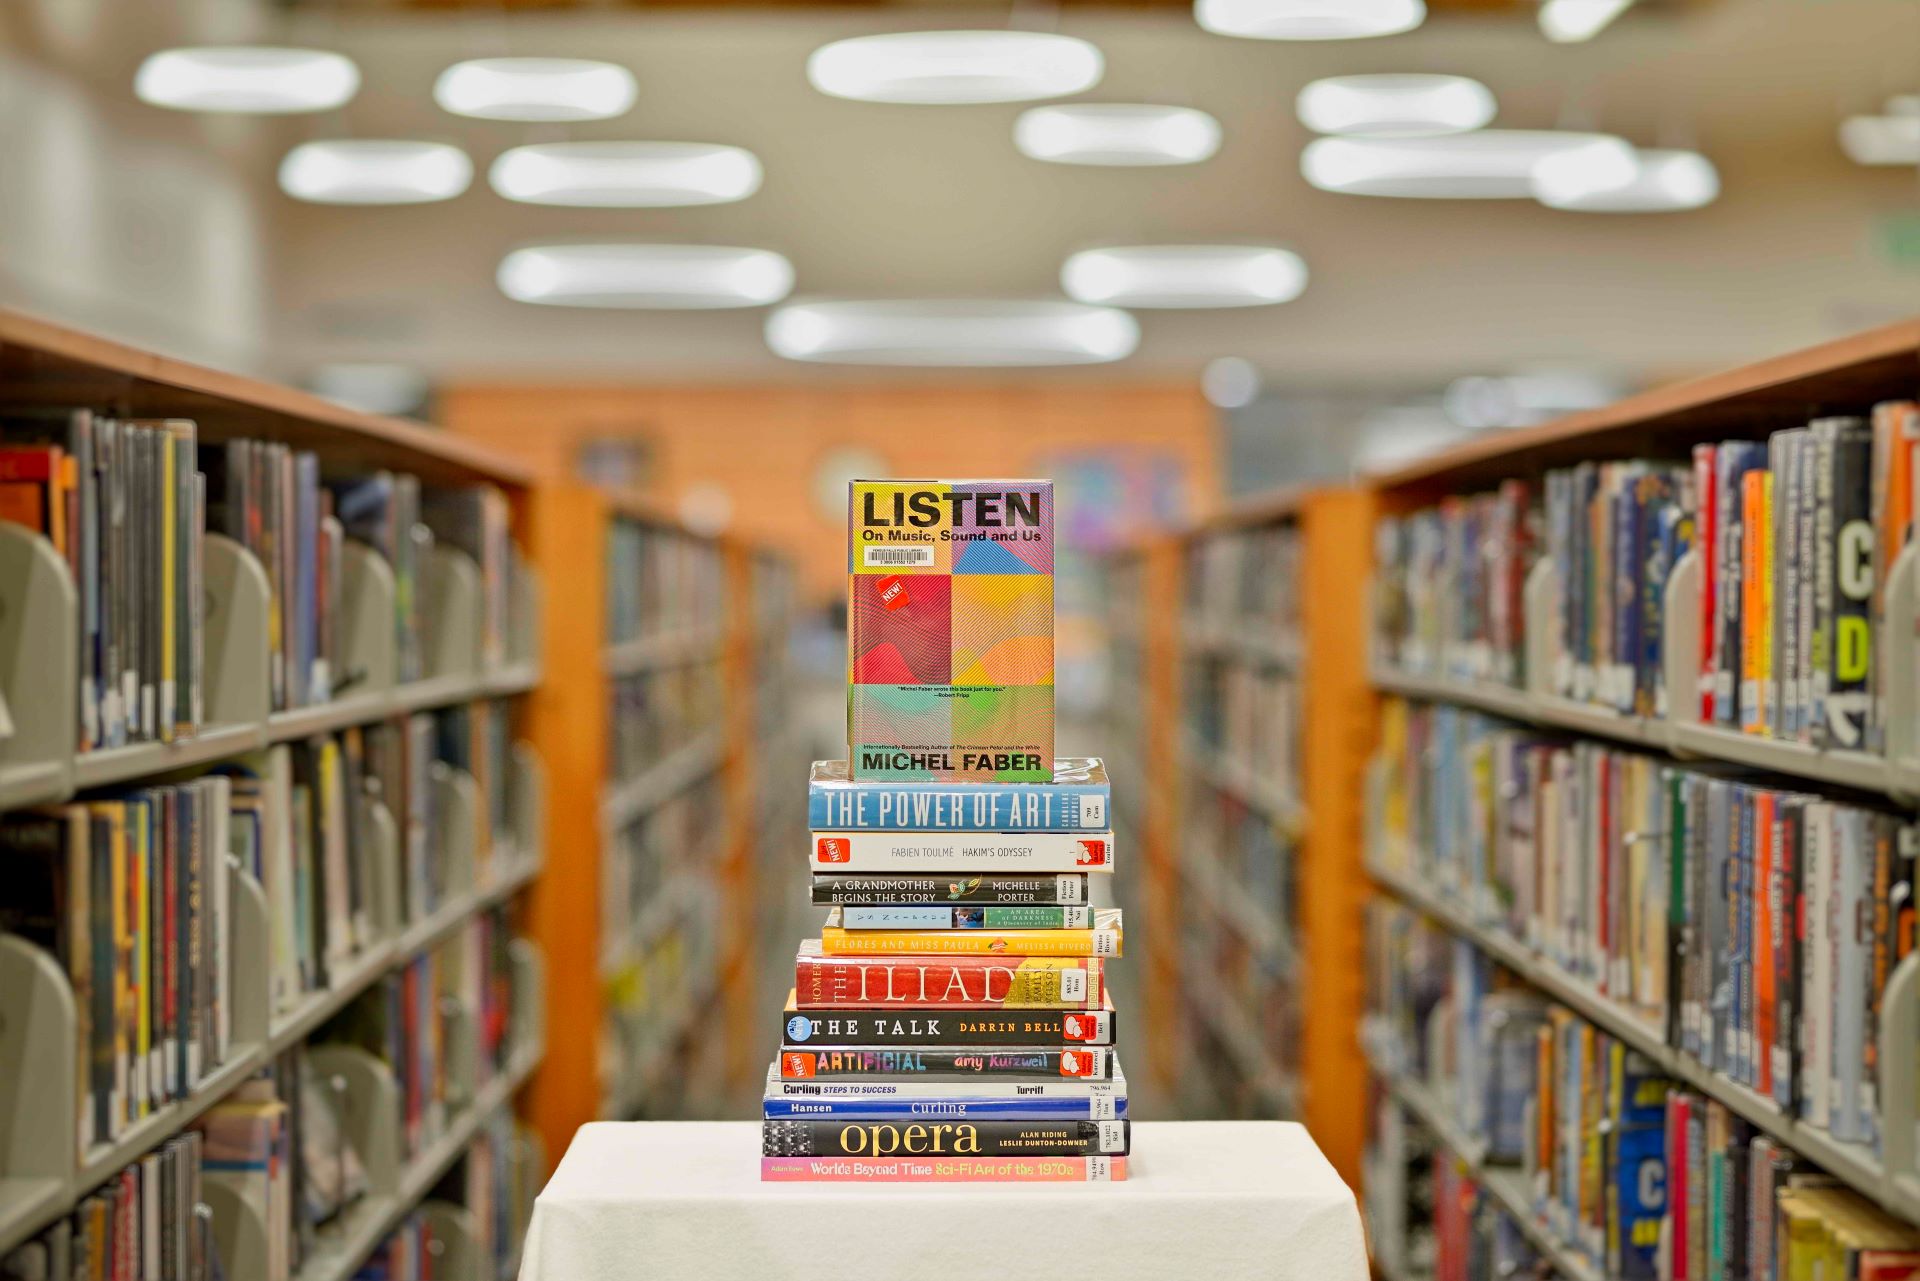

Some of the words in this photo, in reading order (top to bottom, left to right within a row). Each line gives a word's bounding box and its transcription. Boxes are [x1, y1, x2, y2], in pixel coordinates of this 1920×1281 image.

[864, 492, 1040, 528] LISTEN
[862, 530, 884, 541] On
[888, 530, 936, 542] Music,
[940, 530, 986, 541] Sound
[992, 530, 1018, 541] and
[1022, 530, 1042, 541] Us
[882, 582, 903, 602] NEW!
[863, 753, 955, 770] MICHEL
[964, 754, 1041, 771] FABER
[825, 792, 868, 826] THE
[880, 792, 963, 826] POWER
[974, 792, 1000, 826] OF
[1010, 792, 1053, 827] ART
[826, 840, 840, 862] NEW!
[892, 848, 919, 857] FABIEN
[923, 847, 954, 857] TOULMÉ
[962, 848, 994, 857] HAKIM'S
[998, 848, 1032, 857] ODYSSEY
[1808, 824, 1818, 874] TOM
[833, 881, 840, 890] A
[846, 881, 935, 890] GRANDMOTHER
[992, 882, 1040, 890] MICHELLE
[832, 894, 871, 902] BEGINS
[875, 894, 896, 902] THE
[900, 894, 936, 902] STORY
[1805, 884, 1818, 984] CLANCY
[836, 940, 876, 949] FLORES
[882, 940, 904, 949] AND
[912, 941, 938, 949] MISS
[944, 941, 979, 950] PAULA
[813, 963, 821, 1005] HOMER
[834, 966, 846, 1002] THE
[858, 966, 1016, 1001] ILIAD
[811, 1020, 858, 1034] THE
[875, 1020, 940, 1035] TALK
[960, 1024, 1015, 1032] DARRIN
[1024, 1024, 1060, 1032] BELL
[792, 1055, 805, 1076] NEW!
[818, 1052, 926, 1071] ARTIFICIAL
[955, 1056, 984, 1071] amy
[784, 1084, 821, 1095] Curling
[1016, 1086, 1044, 1094] Turriff
[912, 1102, 967, 1116] Curling
[840, 1124, 982, 1156] opera
[811, 1163, 850, 1175] Worlds
[854, 1163, 897, 1177] Beyond
[901, 1163, 932, 1175] Time
[936, 1164, 971, 1175] Sci-Fi
[974, 1164, 995, 1175] Art
[999, 1164, 1011, 1175] of
[1016, 1164, 1034, 1175] the
[1040, 1164, 1074, 1175] 1970s
